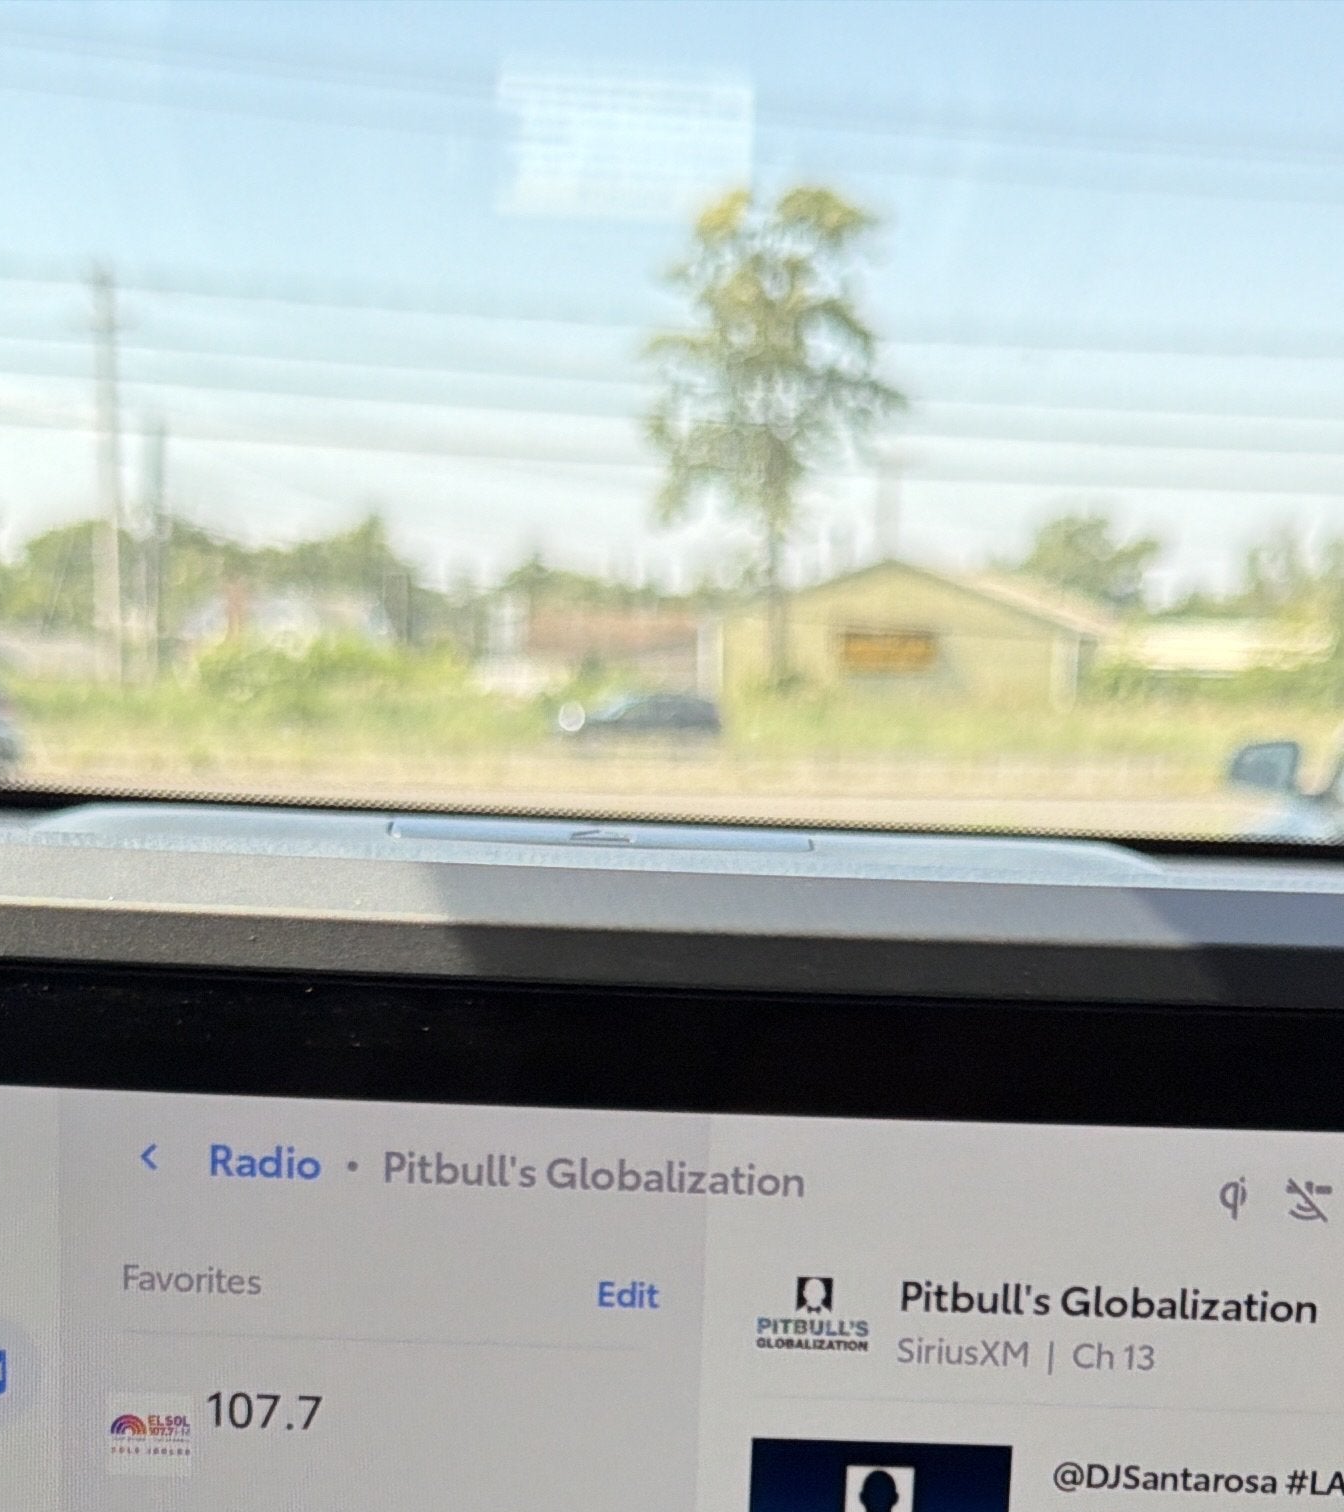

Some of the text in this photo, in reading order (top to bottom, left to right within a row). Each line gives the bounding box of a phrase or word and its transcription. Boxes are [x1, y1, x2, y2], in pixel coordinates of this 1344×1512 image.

[210, 1143, 806, 1198] Radio Pitbull's Globalization
[123, 1264, 262, 1295] Favorites
[597, 1280, 661, 1310] Edit
[900, 1281, 1318, 1324] Pitbull's Globalization
[756, 1317, 869, 1337] PITBULL'S
[756, 1338, 869, 1351] GLOBALIZATION
[896, 1337, 1029, 1368] SiriusXM
[1072, 1341, 1115, 1370] Ch
[1124, 1344, 1156, 1370] 13
[207, 1391, 323, 1431] 107.7
[1053, 1461, 1277, 1494] @DJSantarosa
